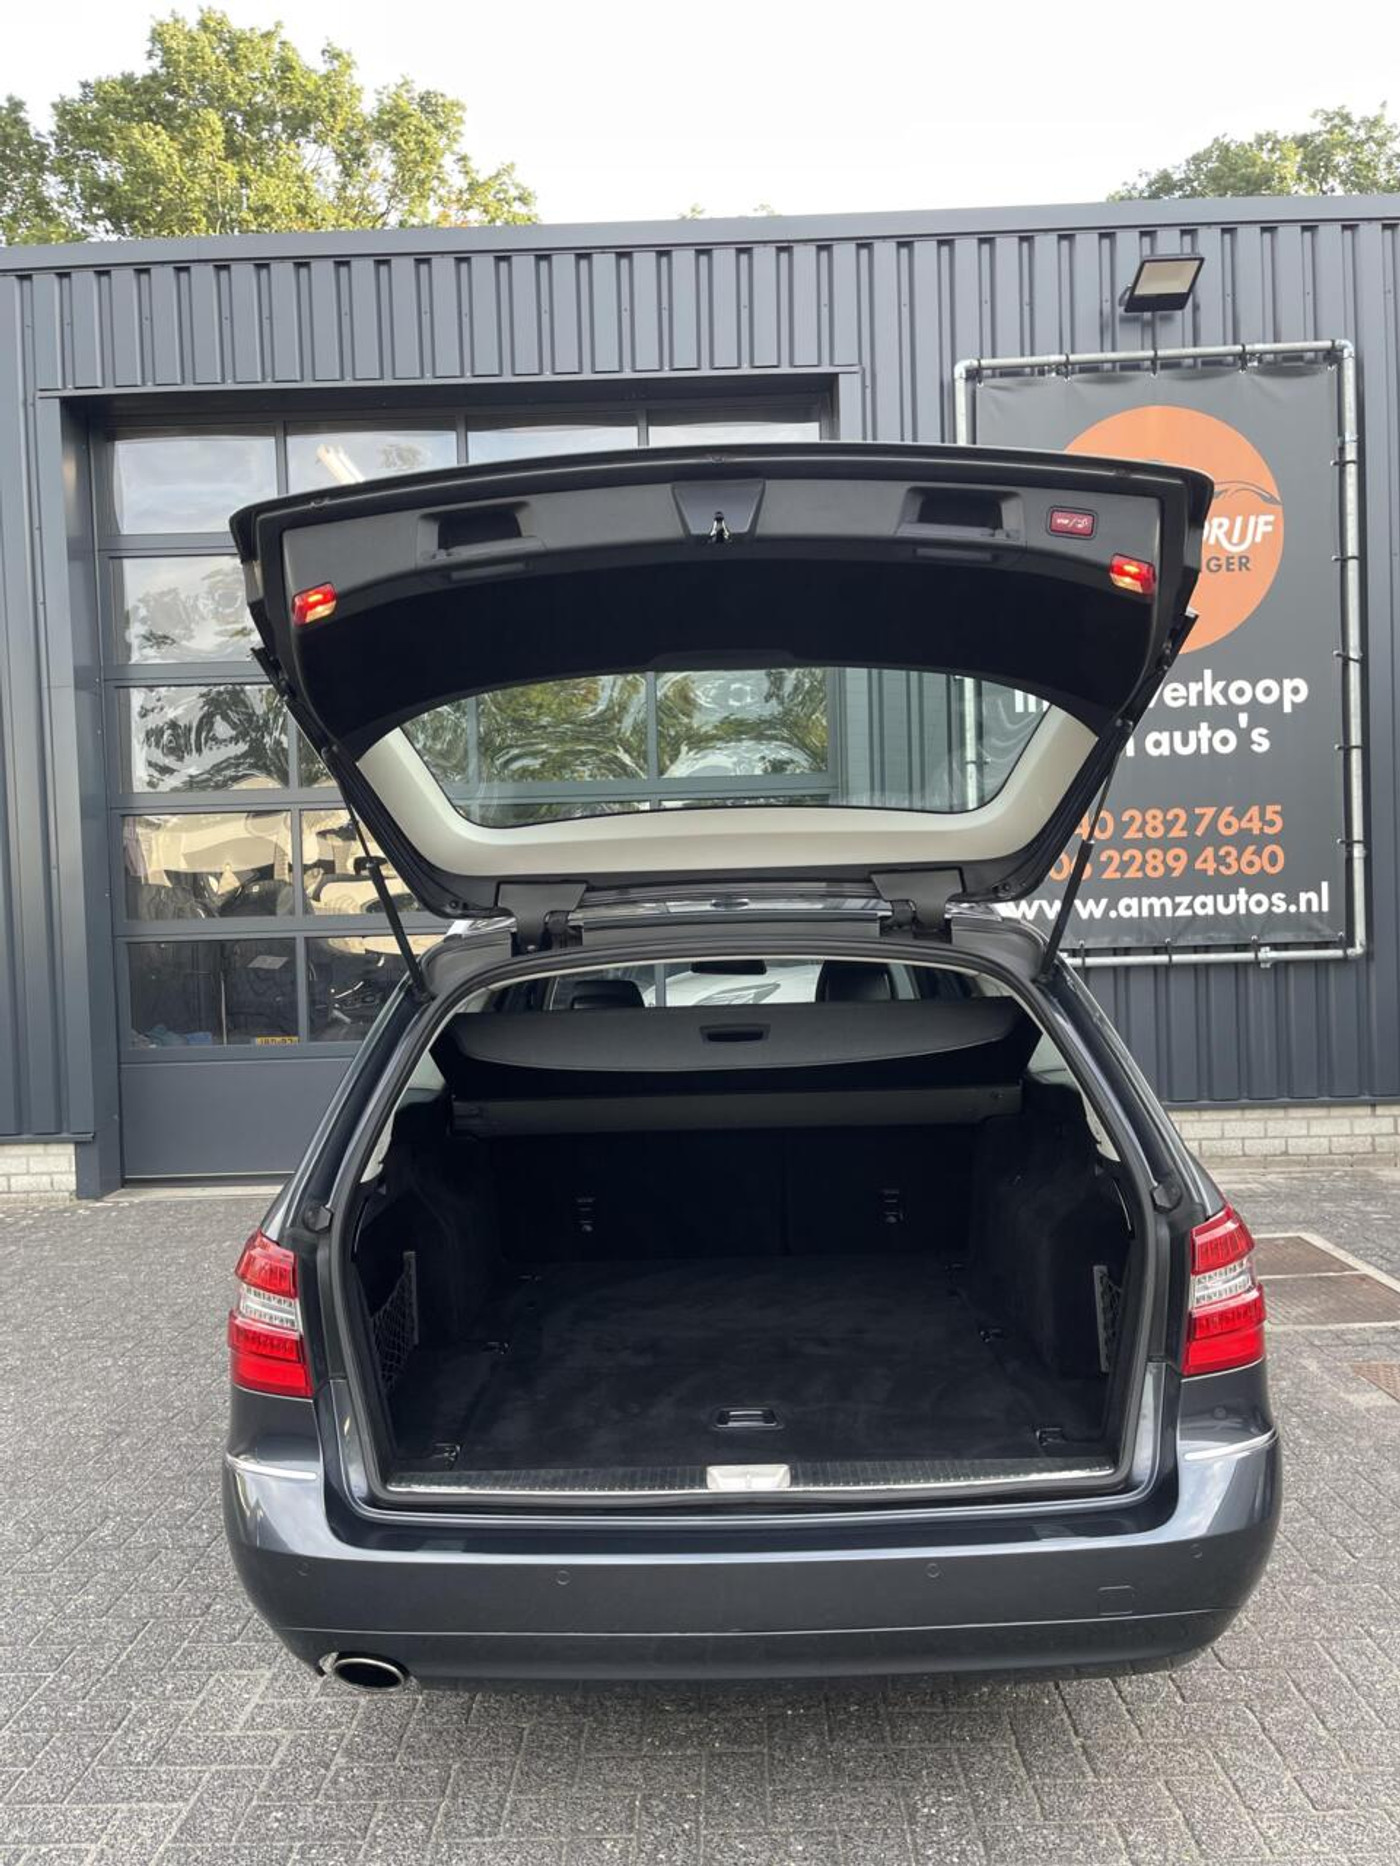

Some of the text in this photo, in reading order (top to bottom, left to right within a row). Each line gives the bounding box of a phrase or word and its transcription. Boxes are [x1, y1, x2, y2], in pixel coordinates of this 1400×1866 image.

[1145, 712, 1271, 757] auto's
[1121, 807, 1188, 839] 282
[1194, 804, 1284, 837] 7645
[1100, 847, 1189, 879] 2289
[1194, 844, 1285, 875] 4360
